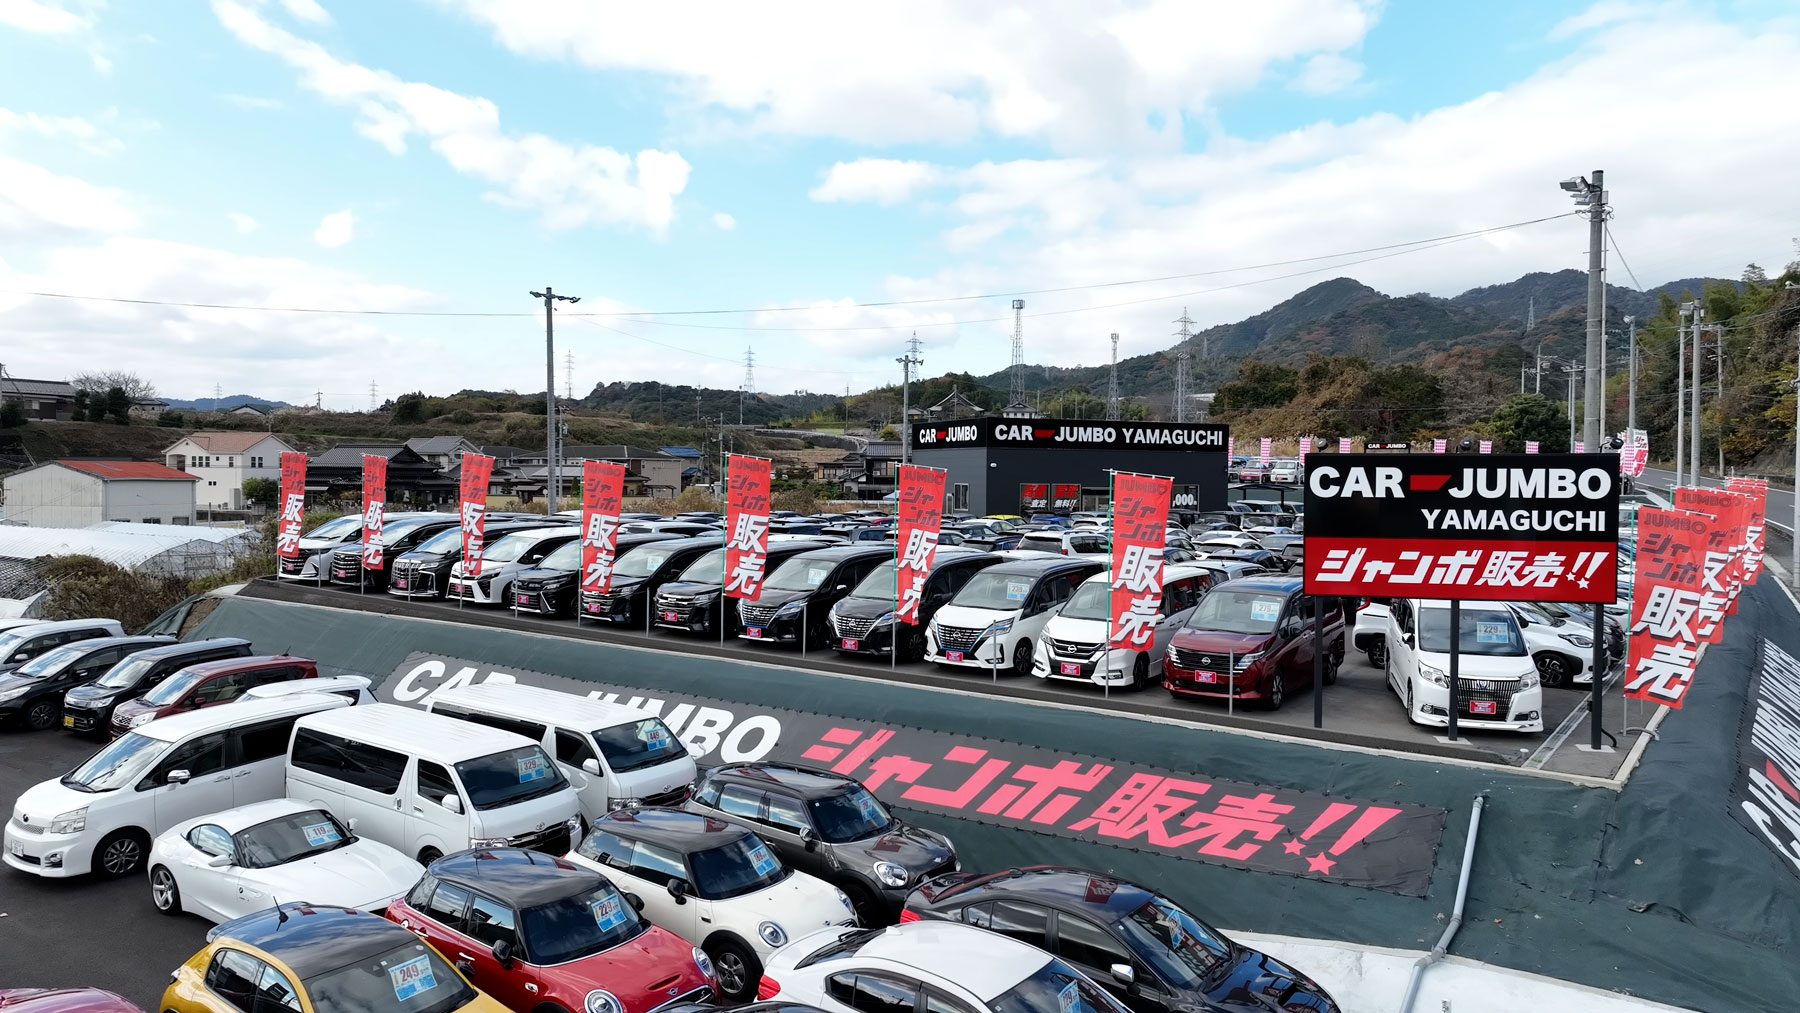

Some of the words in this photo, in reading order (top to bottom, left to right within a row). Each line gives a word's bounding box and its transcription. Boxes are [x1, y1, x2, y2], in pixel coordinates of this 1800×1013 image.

[919, 428, 937, 444] CAR
[945, 425, 978, 442] JUMBO
[994, 424, 1033, 441] CAR
[1054, 426, 1117, 443] JUMBO
[1122, 428, 1223, 446] YAMAGUCHI
[1119, 479, 1168, 495] JUMBO
[1309, 466, 1405, 498] CAR
[1448, 467, 1612, 499] JUMBO
[1421, 509, 1606, 532] YAMAGUCHI
[1643, 513, 1707, 534] JUMBO
[725, 512, 769, 596] 販売
[1110, 544, 1164, 645] 販売
[1483, 625, 1499, 634] 229
[1624, 584, 1701, 700] 販売
[523, 760, 537, 771] 329
[312, 826, 327, 836] 119
[400, 964, 420, 982] 249
